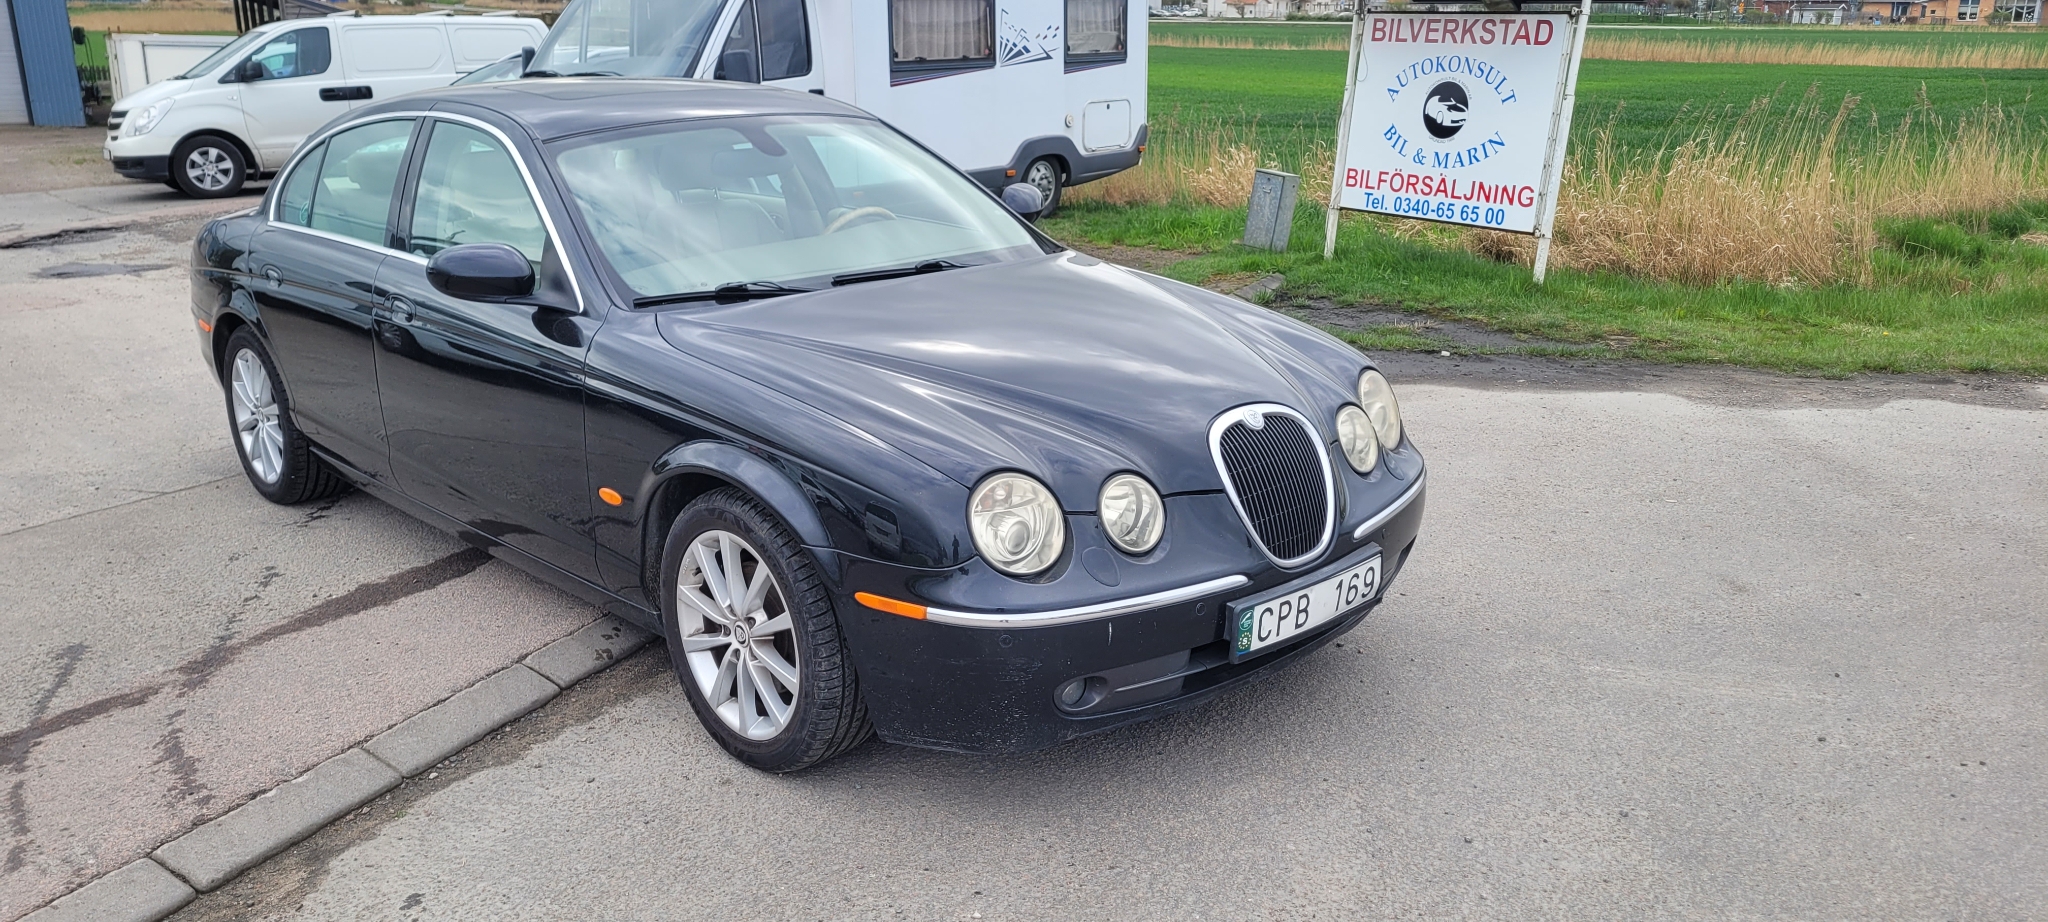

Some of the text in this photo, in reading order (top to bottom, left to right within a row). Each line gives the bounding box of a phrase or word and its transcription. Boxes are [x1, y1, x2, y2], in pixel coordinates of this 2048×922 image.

[1371, 18, 1554, 46] BILVERKSTAD
[1386, 55, 1517, 105] AUTOKONSULT
[1383, 123, 1506, 169] BIL & MARIN
[1345, 167, 1535, 208] BILFÖRSÄLJNING
[1364, 192, 1505, 226] Tel. 0340-65 65 00
[1257, 566, 1375, 643] CPB 169
[1242, 637, 1248, 645] S
